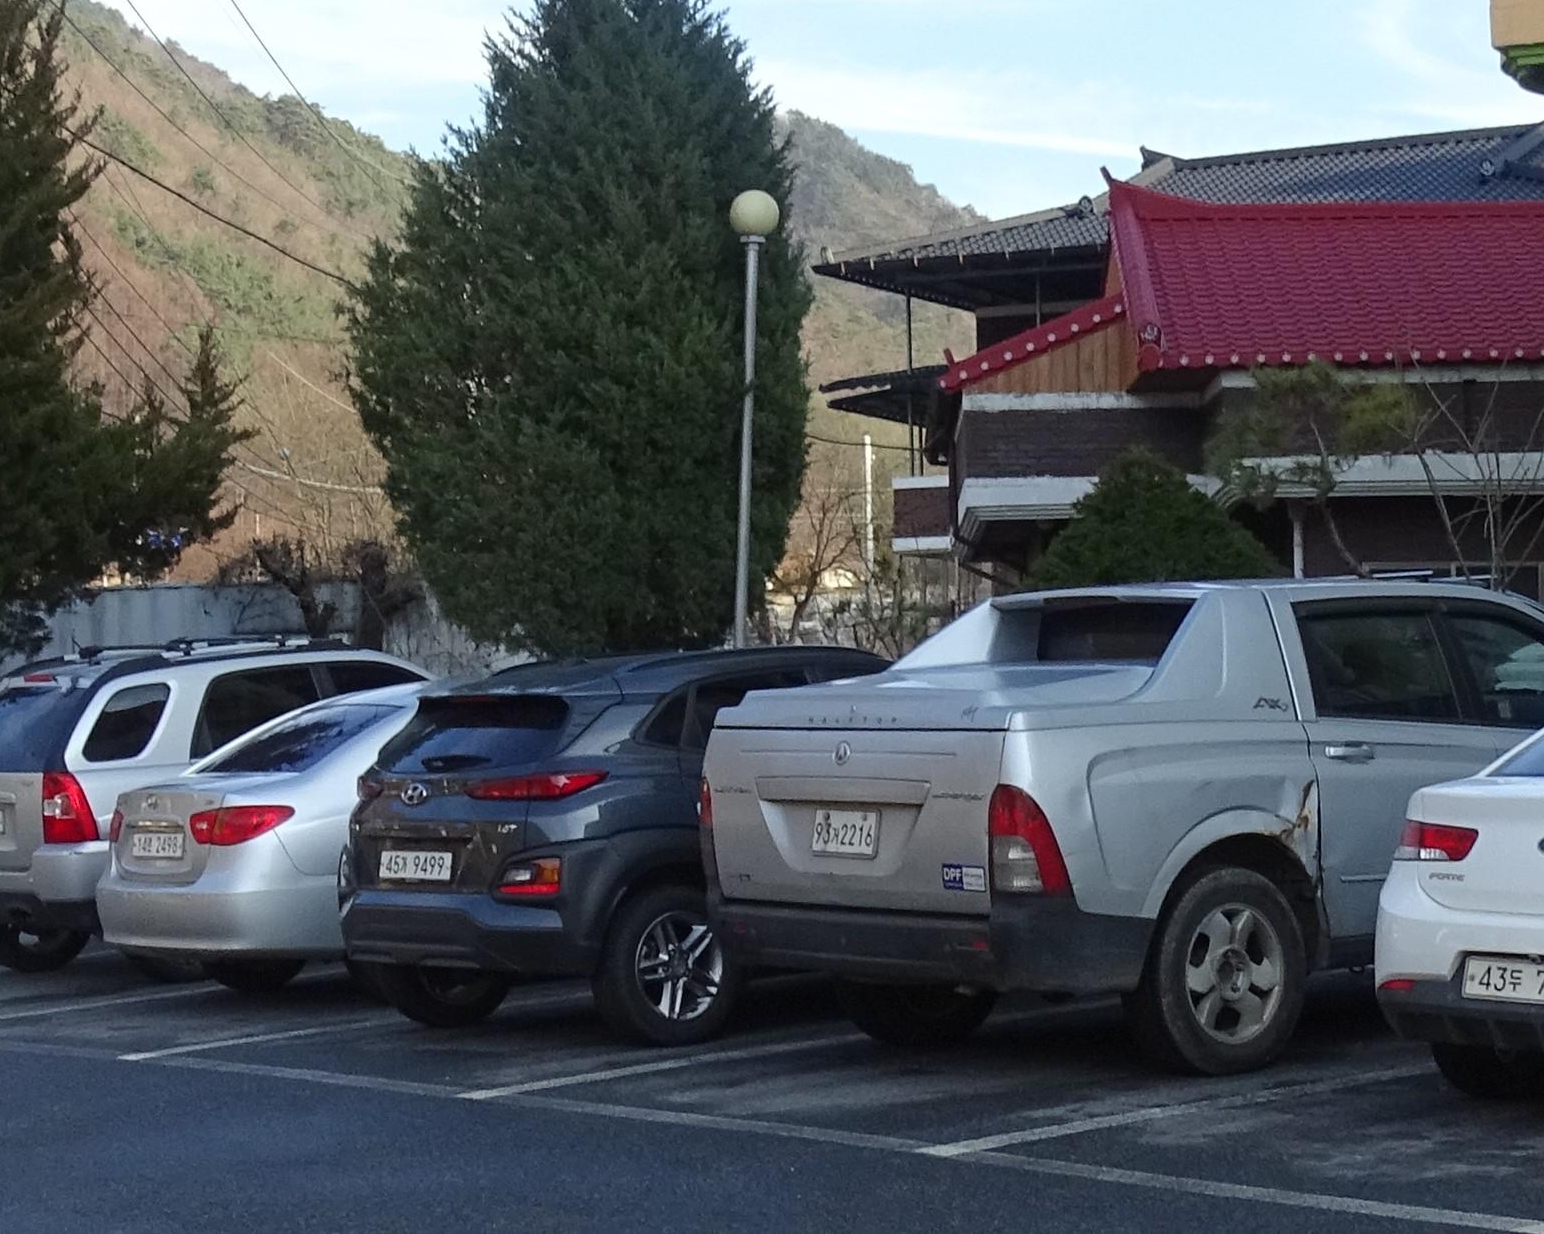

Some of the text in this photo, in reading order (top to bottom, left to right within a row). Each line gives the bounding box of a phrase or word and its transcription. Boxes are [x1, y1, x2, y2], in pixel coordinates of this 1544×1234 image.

[413, 855, 445, 876] 9499
[943, 866, 962, 881] DPF
[1478, 966, 1523, 992] 43두
